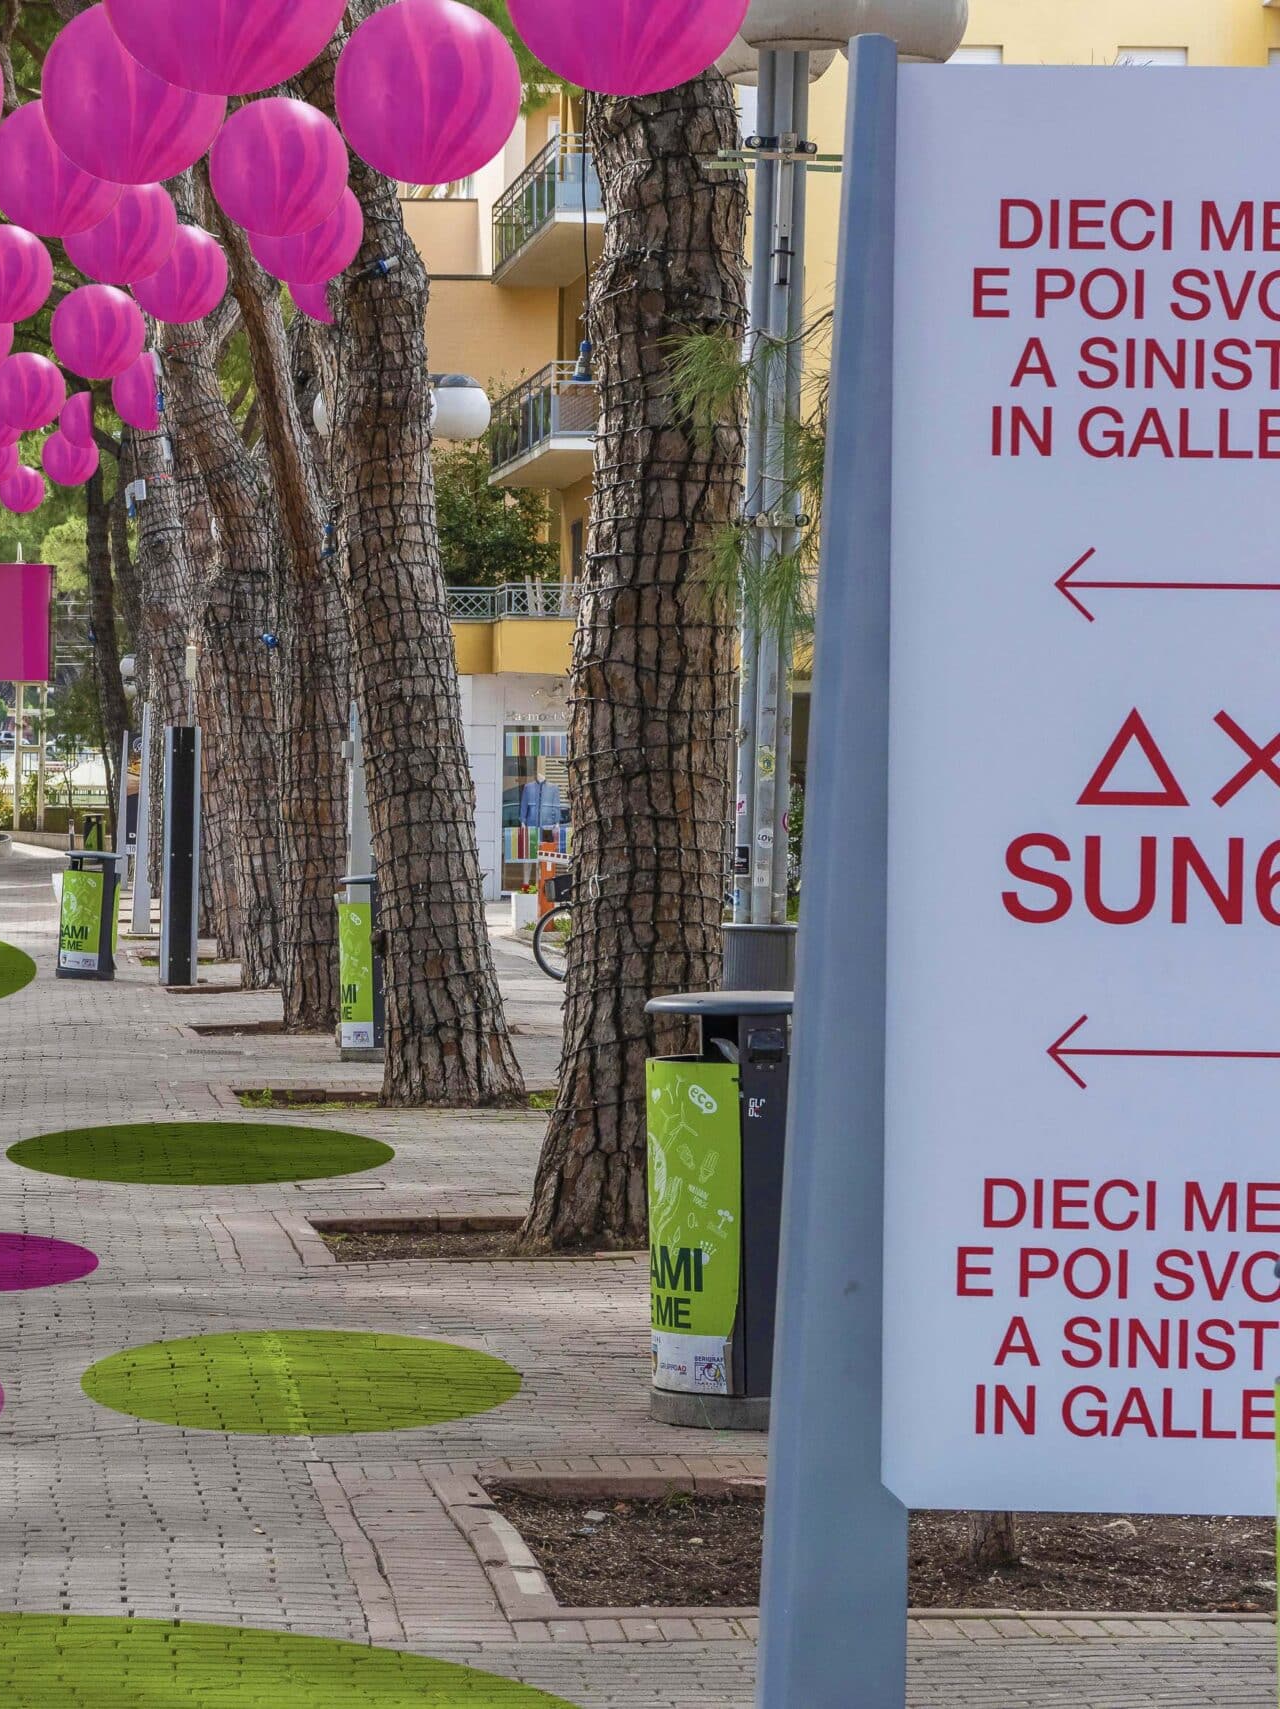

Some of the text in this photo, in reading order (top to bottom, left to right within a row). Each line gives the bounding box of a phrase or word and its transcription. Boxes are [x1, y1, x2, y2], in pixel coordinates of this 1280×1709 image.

[1000, 199, 1172, 251] DIECI
[973, 268, 1010, 318] E
[1035, 268, 1144, 320] POI
[1011, 337, 1056, 387] A
[992, 406, 1052, 456] IN
[690, 1086, 714, 1110] eco
[984, 1178, 1156, 1232] DIECI
[956, 1246, 993, 1297] E
[1019, 1247, 1128, 1299] POI
[656, 1294, 691, 1329] ME
[995, 1316, 1040, 1366] A
[975, 1384, 1036, 1435] IN
